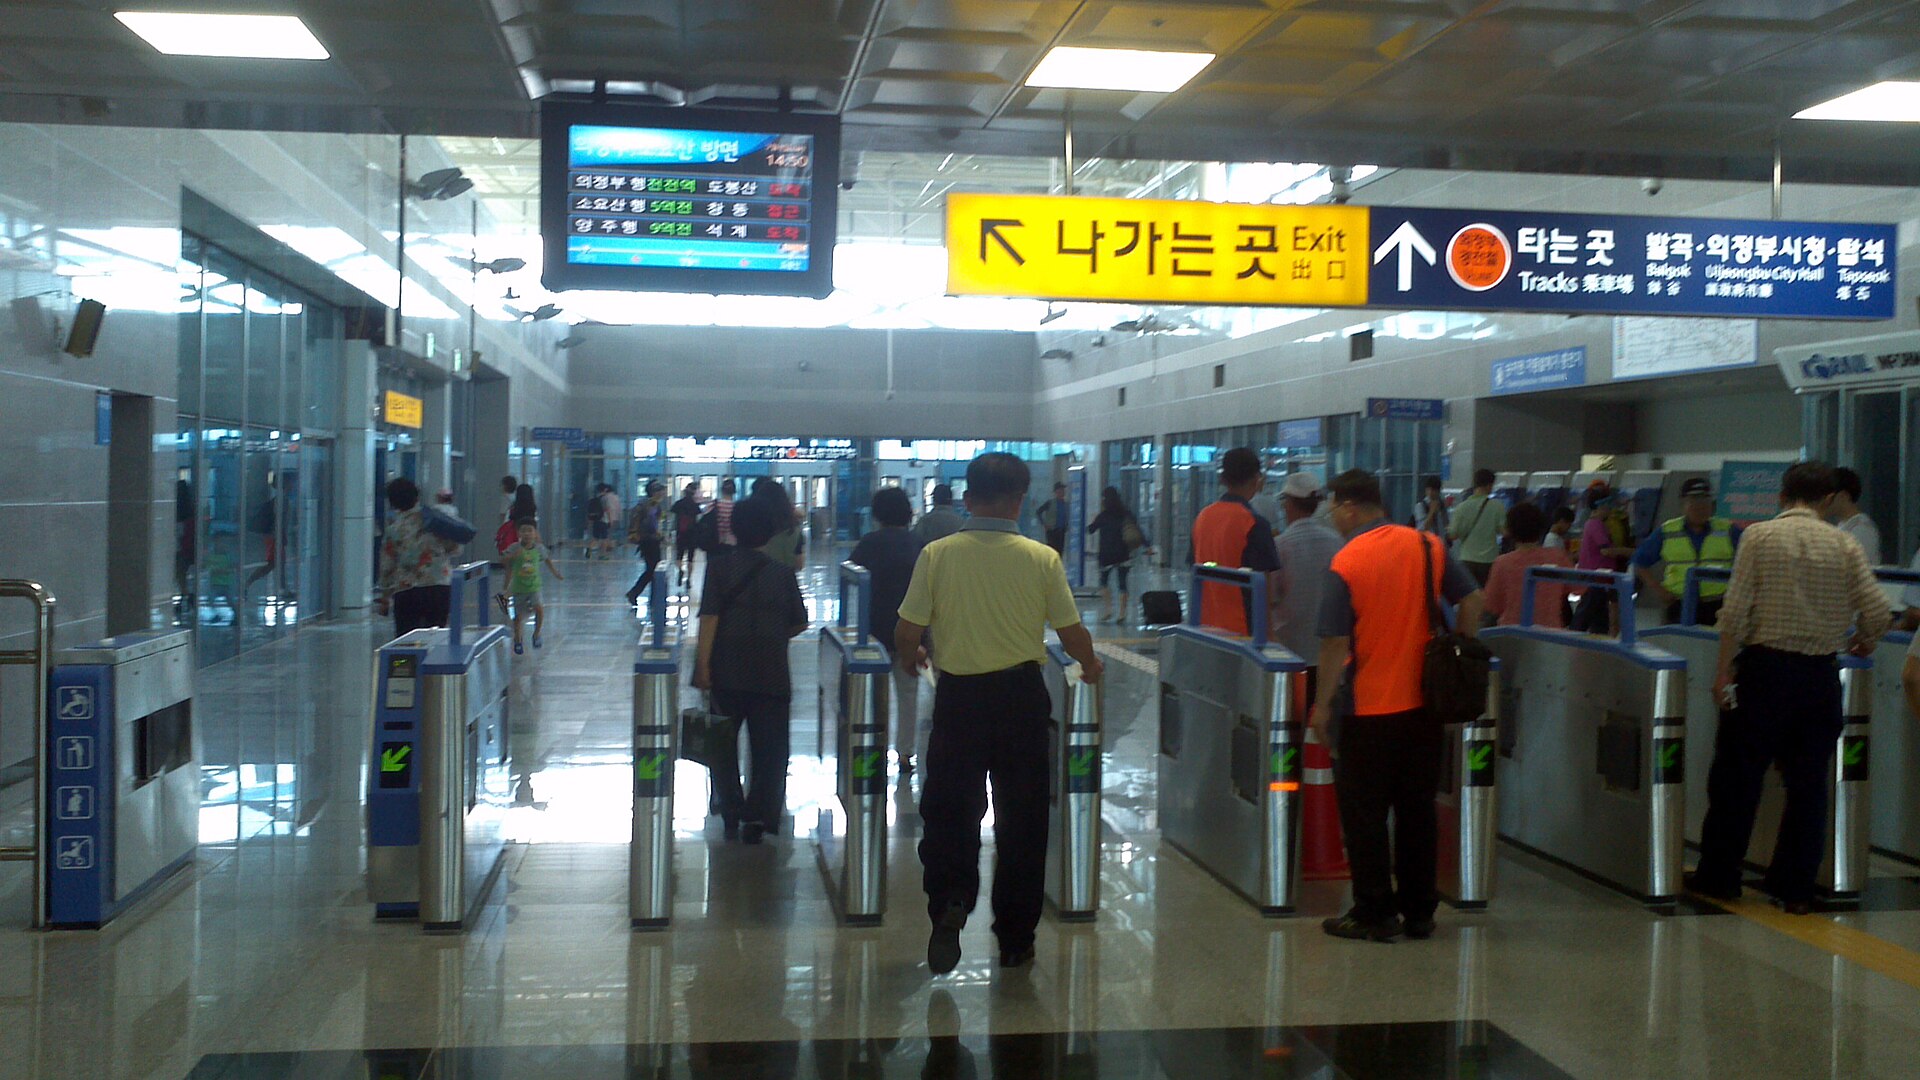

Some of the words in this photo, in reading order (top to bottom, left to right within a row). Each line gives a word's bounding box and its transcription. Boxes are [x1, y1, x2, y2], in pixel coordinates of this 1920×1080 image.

[701, 139, 739, 163] 방면
[575, 174, 627, 191] 의정부
[707, 180, 758, 195] 도봉산
[575, 196, 627, 212] 소요산
[1057, 218, 1214, 277] 나가는
[1235, 223, 1279, 281] 곳
[1292, 225, 1346, 254] Exit
[1517, 227, 1579, 264] 타는
[1584, 229, 1616, 266] 곳
[1291, 258, 1346, 280] 出口
[1772, 265, 1798, 284] City
[1798, 266, 1825, 282] Hall
[1517, 271, 1579, 293] Tracks
